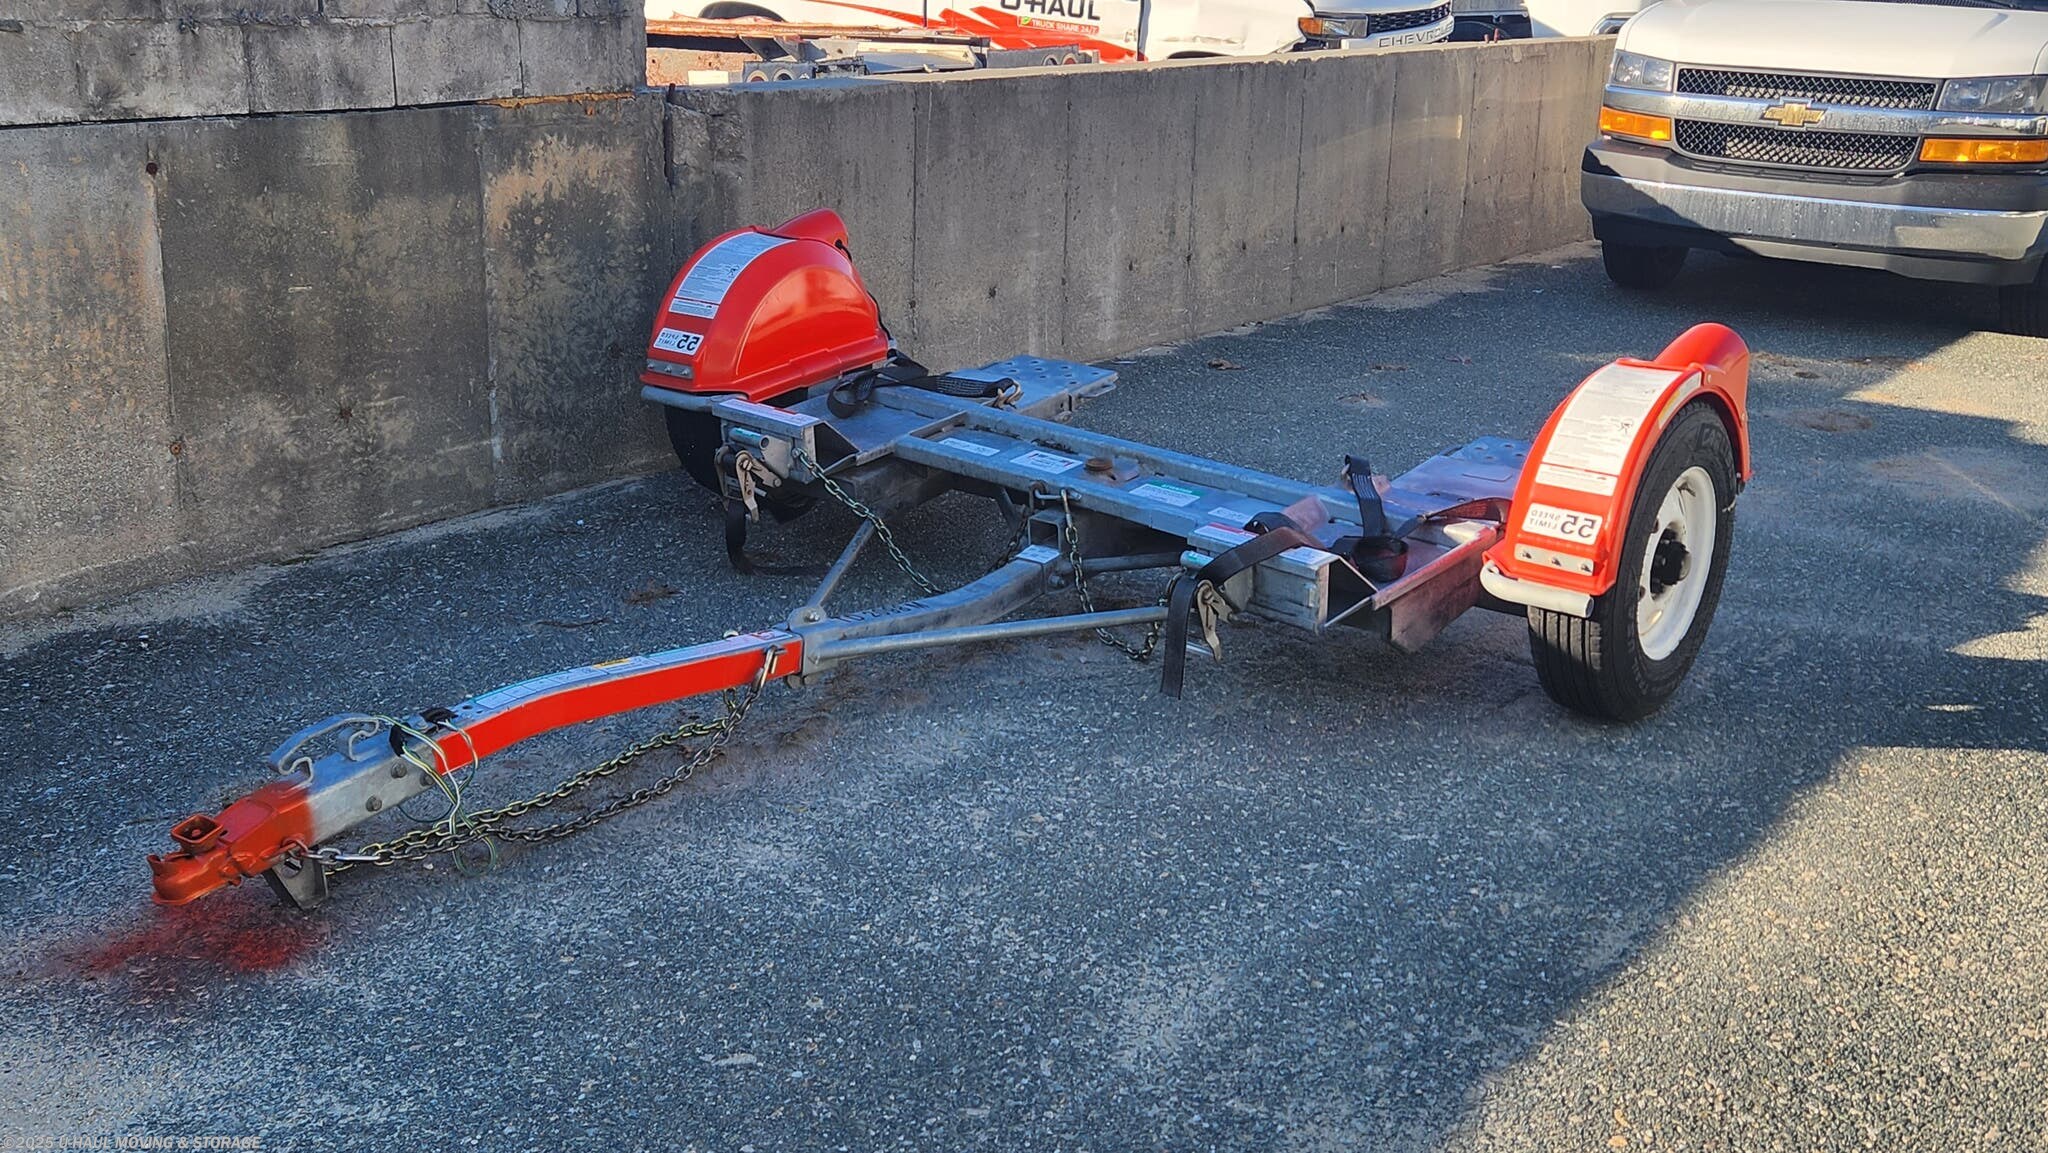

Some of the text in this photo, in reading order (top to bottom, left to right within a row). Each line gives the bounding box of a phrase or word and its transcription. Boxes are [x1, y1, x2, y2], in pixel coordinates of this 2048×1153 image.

[1032, 18, 1099, 35] TRUCK SHARE 24/7
